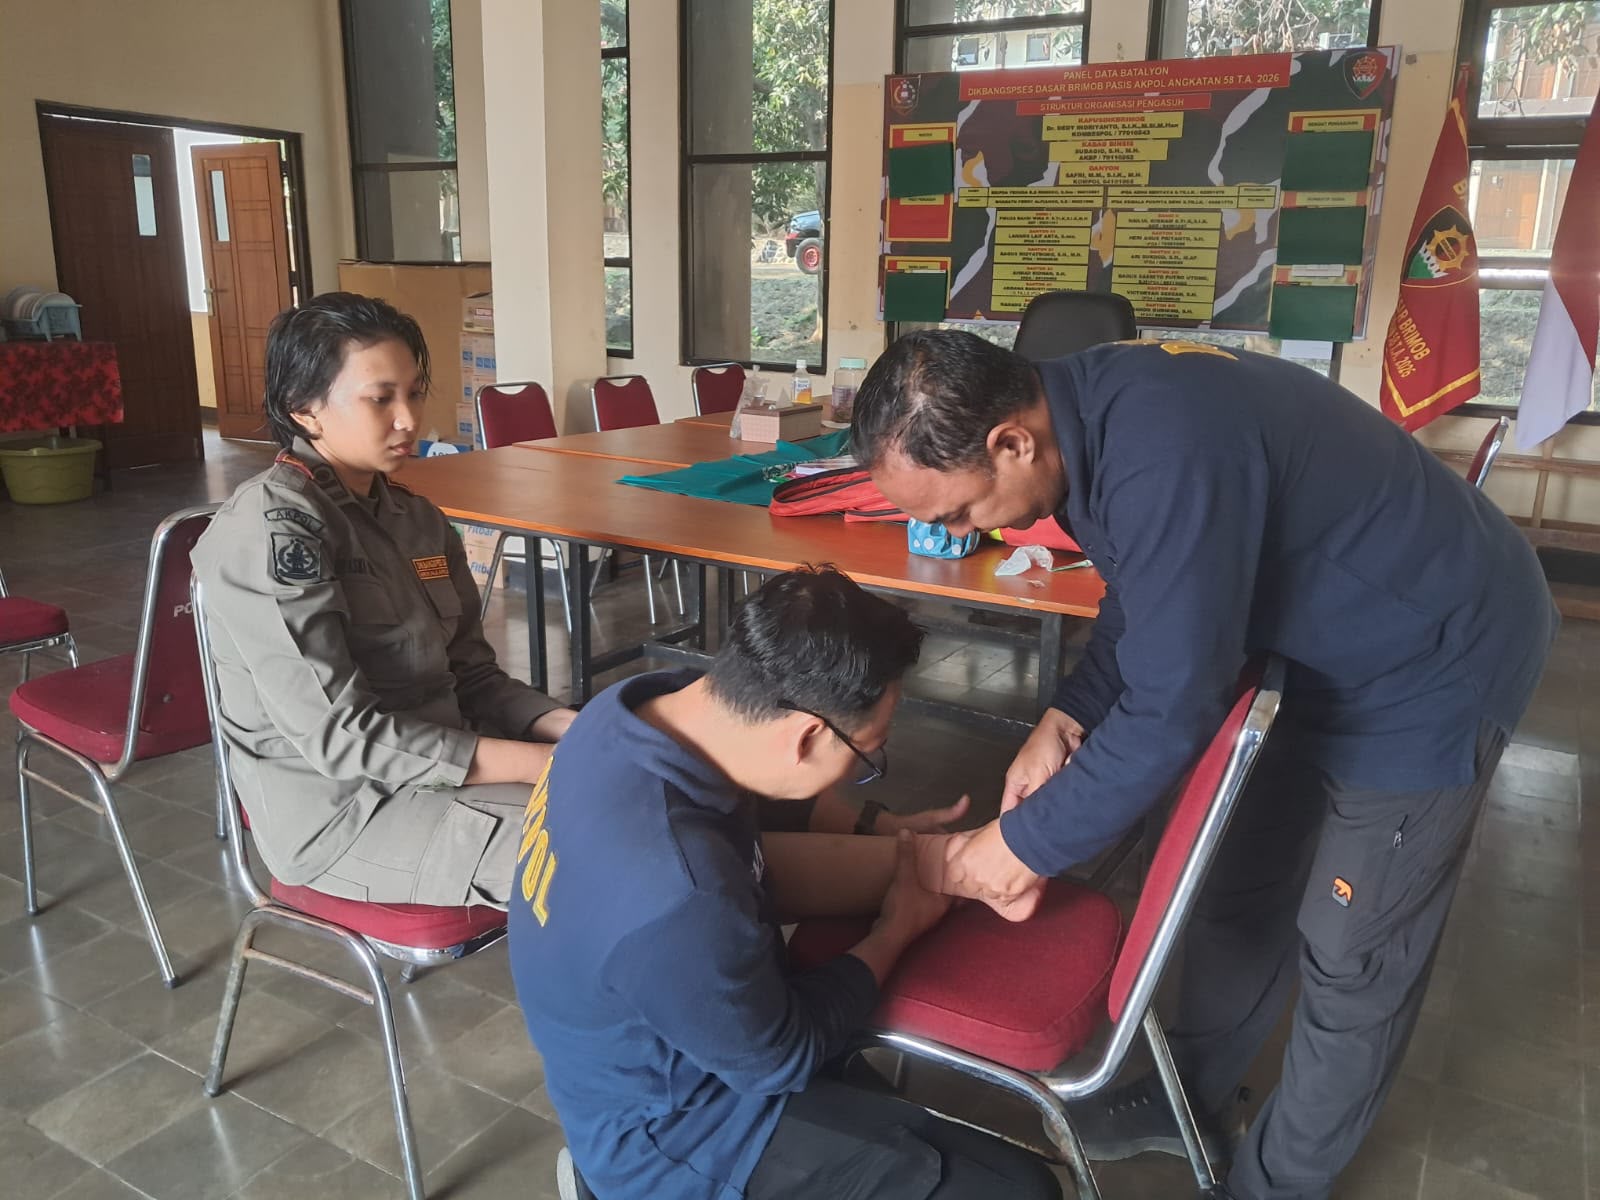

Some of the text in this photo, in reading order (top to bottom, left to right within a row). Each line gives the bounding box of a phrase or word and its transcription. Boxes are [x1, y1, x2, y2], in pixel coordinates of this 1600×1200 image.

[1063, 66, 1169, 80] PANEL DATA BATALYON
[968, 85, 1034, 96] DIKBANGSPSES
[1035, 83, 1066, 93] DASAR
[1068, 81, 1104, 91] BRIMOB
[1105, 80, 1132, 90] PASIS
[1134, 78, 1166, 89] AKPOL
[1168, 77, 1221, 88] ANGKATAN
[1223, 75, 1234, 84] 58
[1257, 73, 1280, 83] 2026
[1040, 98, 1184, 111] STRUKTUR ORGANISASI PENGASUH
[1399, 318, 1431, 361] BRIMOB
